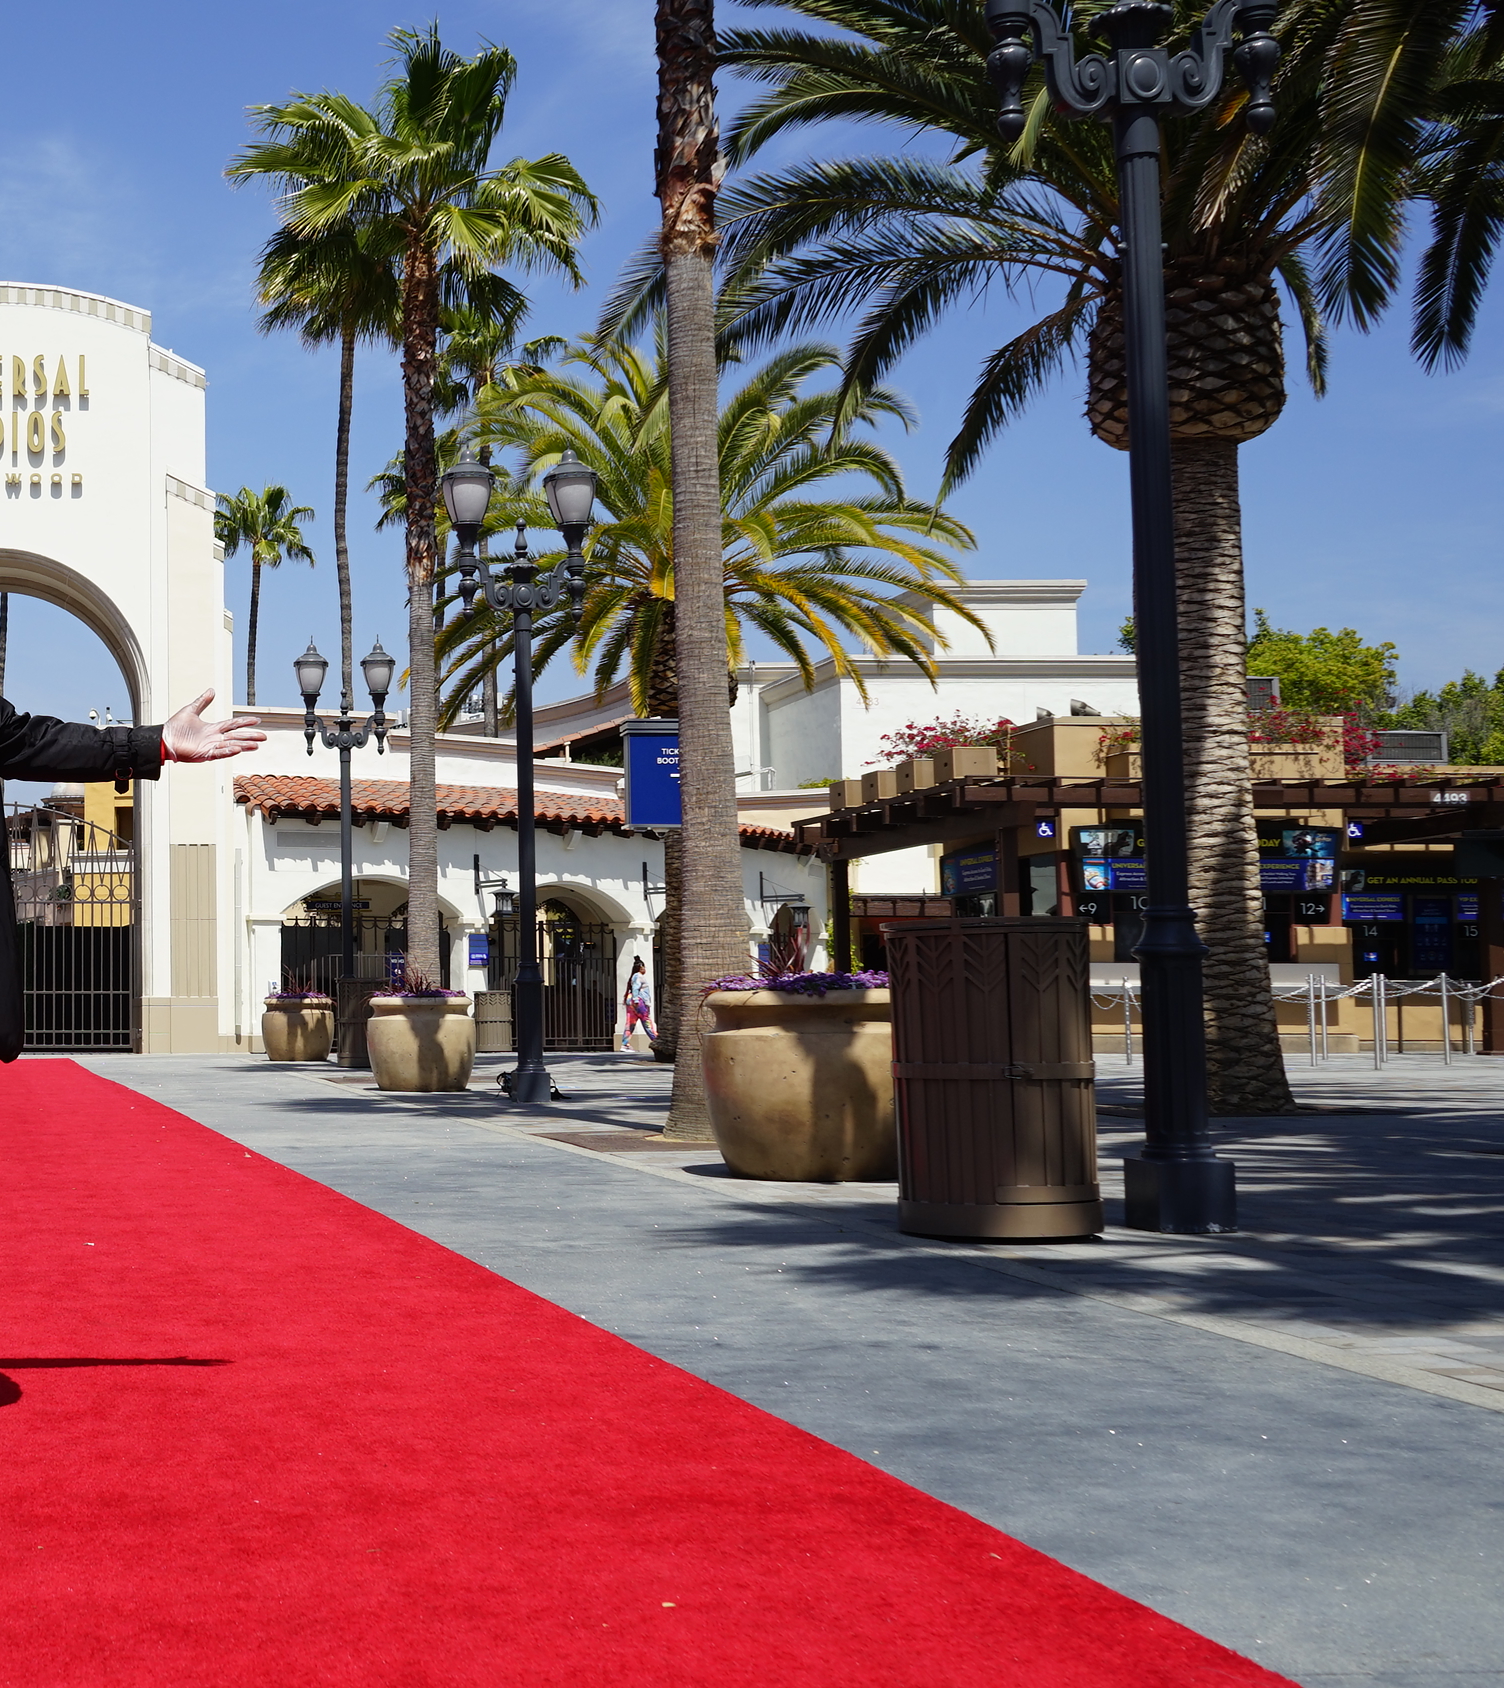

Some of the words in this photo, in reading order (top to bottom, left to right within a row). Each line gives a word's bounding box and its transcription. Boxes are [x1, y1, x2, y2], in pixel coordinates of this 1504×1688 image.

[1433, 793, 1468, 804] 4493
[1088, 903, 1097, 914] 9
[1300, 903, 1316, 915] 12
[1362, 925, 1378, 937] 14
[1464, 925, 1478, 937] 15
